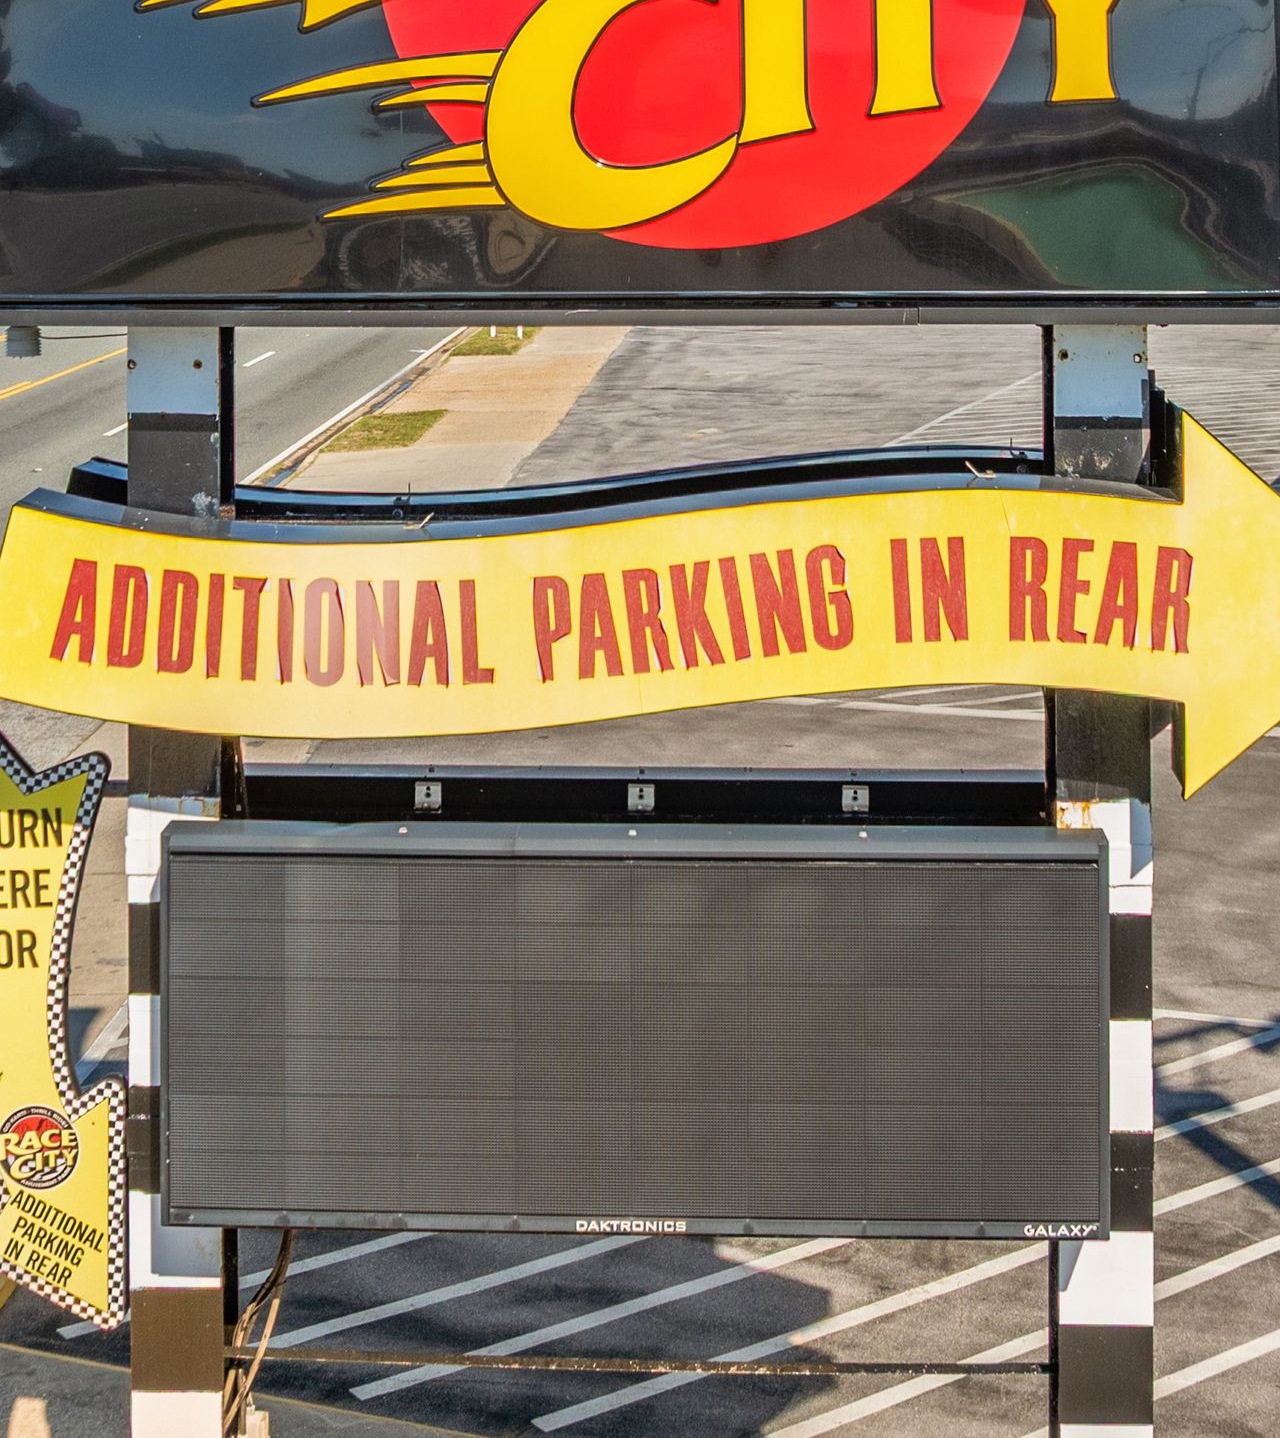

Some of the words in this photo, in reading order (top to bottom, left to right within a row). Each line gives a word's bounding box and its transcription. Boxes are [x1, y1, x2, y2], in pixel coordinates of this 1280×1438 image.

[49, 557, 496, 688] ADDITIONAL
[531, 543, 854, 683] PARKING
[889, 534, 970, 644] IN
[1008, 534, 1195, 655] REAR
[9, 1149, 79, 1181] CITY
[10, 1189, 106, 1253] ADDITIONAL
[12, 1215, 85, 1267] PARKING
[575, 1220, 687, 1232] DAKTRONICS
[3, 1237, 25, 1261] IN
[25, 1249, 72, 1288] REAR
